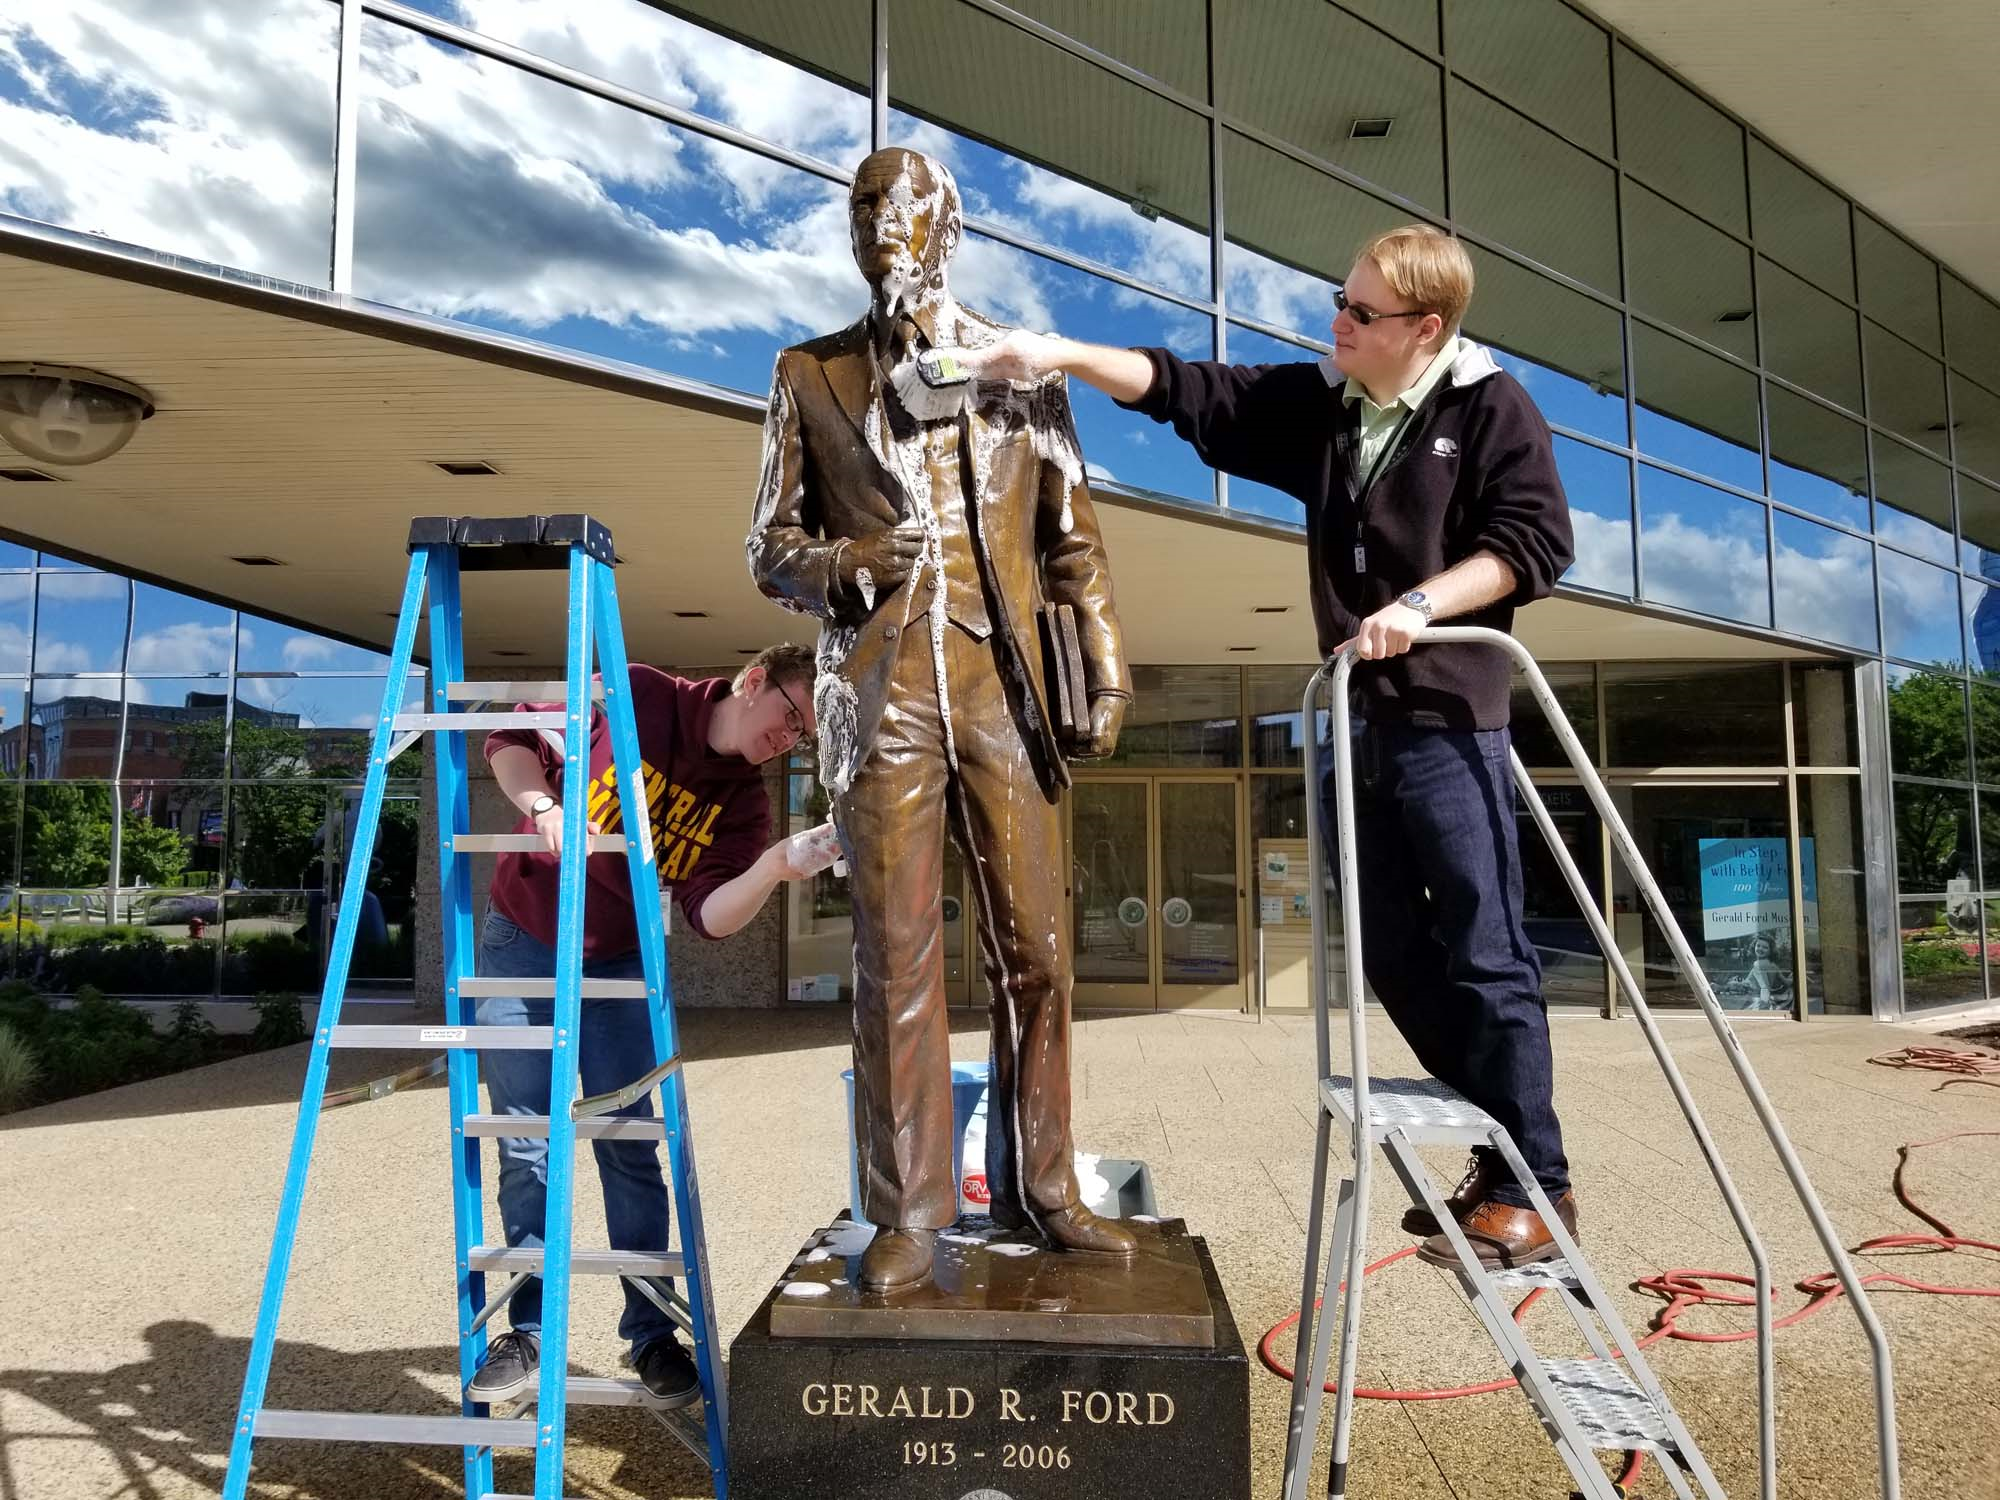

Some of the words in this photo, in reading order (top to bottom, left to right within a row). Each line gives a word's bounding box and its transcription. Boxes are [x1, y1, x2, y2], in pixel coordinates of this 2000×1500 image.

[1734, 846, 1745, 858] In
[1749, 845, 1778, 861] Step
[1711, 864, 1736, 877] with
[1740, 863, 1772, 880] Betty
[1733, 883, 1752, 893] 100
[1711, 911, 1743, 924] Gerald
[1746, 911, 1768, 924] Ford
[803, 1384, 974, 1418] GERALD
[1000, 1389, 1035, 1421] R.
[1062, 1391, 1174, 1425] FORD
[904, 1442, 955, 1465] 1913
[1003, 1445, 1070, 1469] 2006
